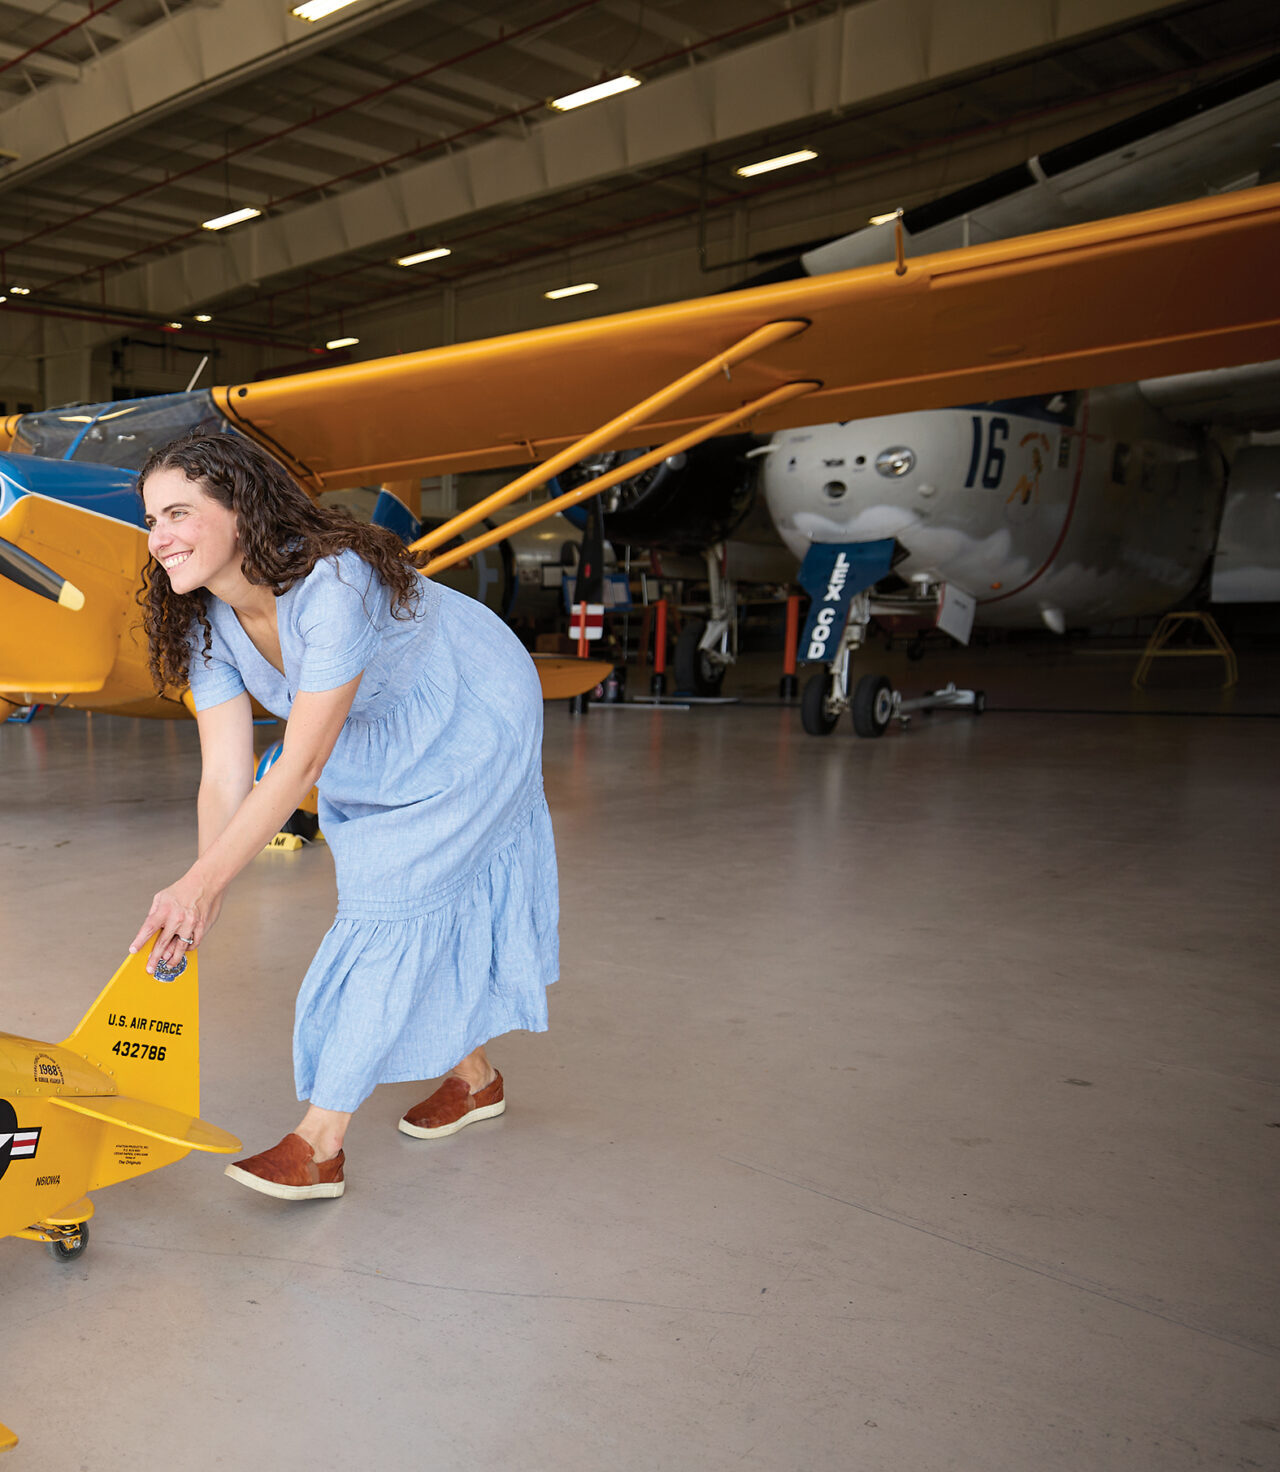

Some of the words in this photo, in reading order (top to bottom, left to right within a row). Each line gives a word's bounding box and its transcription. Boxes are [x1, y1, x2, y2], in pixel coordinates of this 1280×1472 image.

[964, 416, 1010, 490] 16
[823, 552, 850, 601] LEX
[807, 607, 836, 660] COD
[108, 1013, 128, 1028] U.S.
[130, 1017, 147, 1030] AIR
[149, 1020, 183, 1036] FORCE
[112, 1040, 167, 1061] 432786
[38, 1064, 58, 1076] 1988
